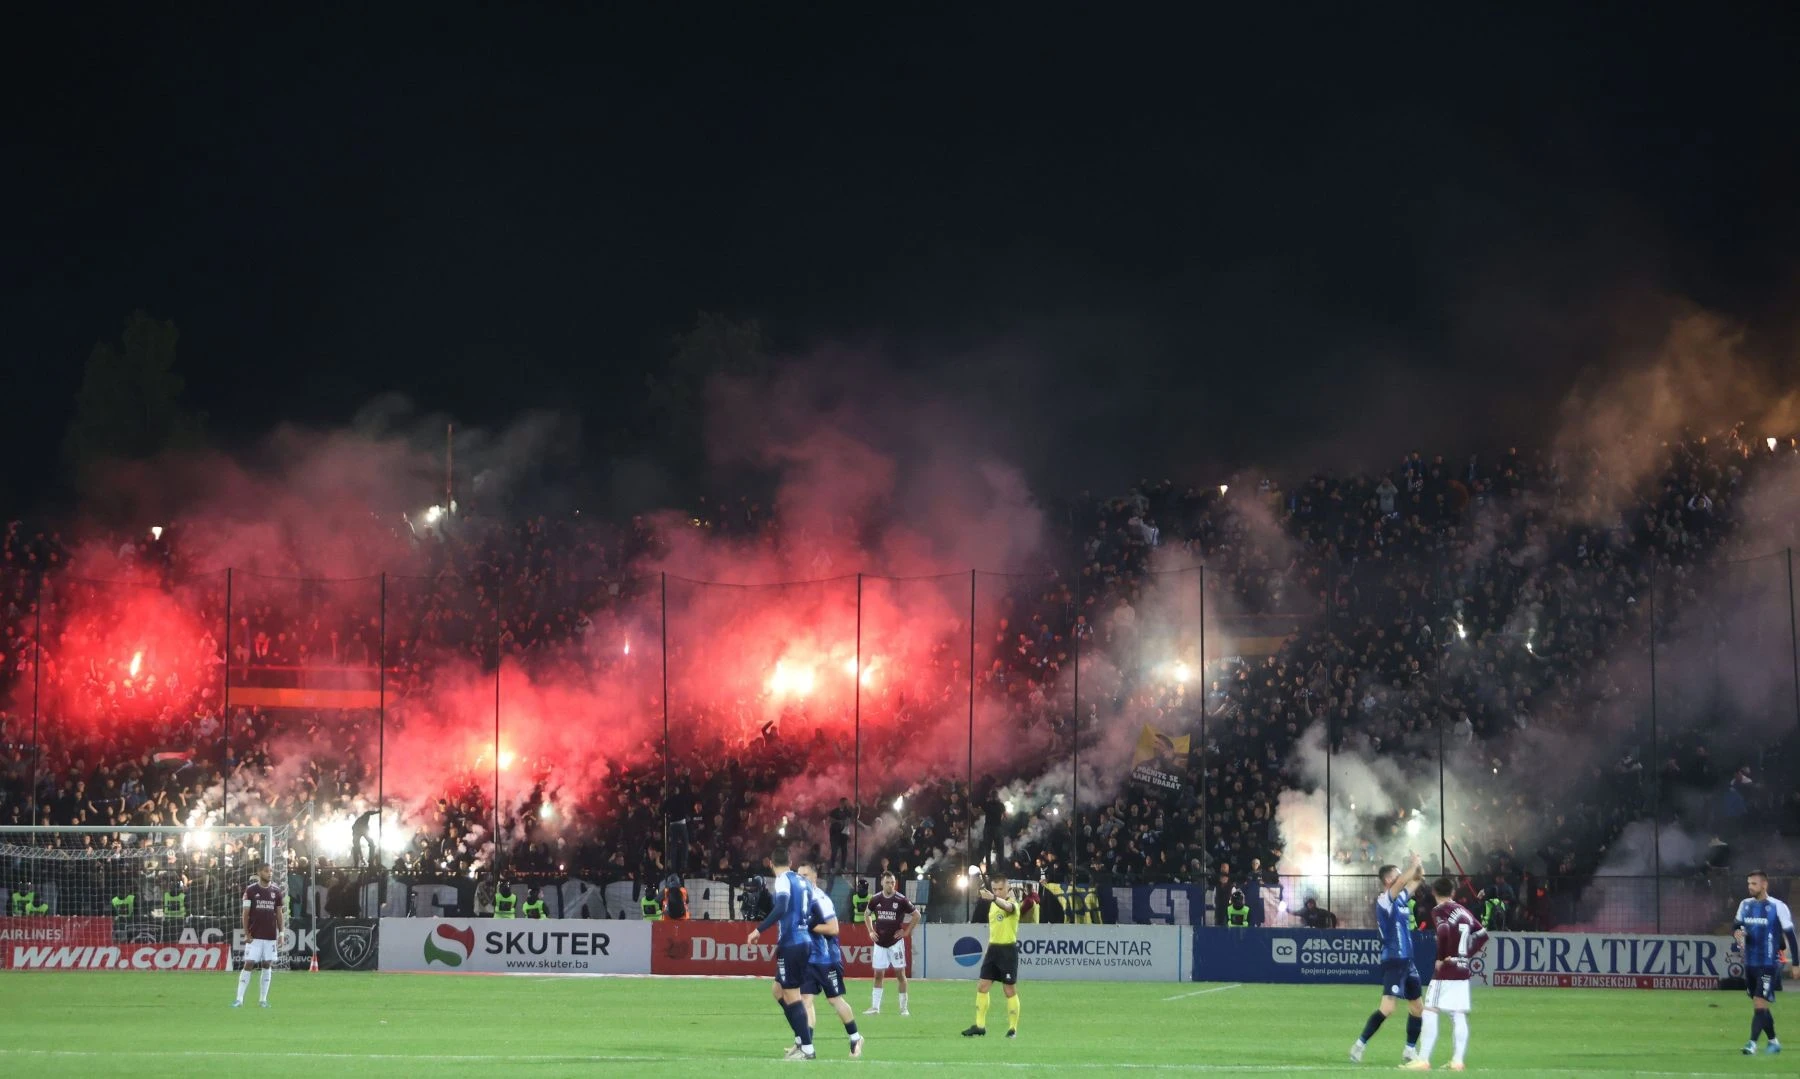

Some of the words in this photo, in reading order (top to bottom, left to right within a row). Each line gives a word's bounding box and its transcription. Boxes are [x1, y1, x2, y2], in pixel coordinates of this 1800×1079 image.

[1169, 775, 1179, 783] SE
[0, 928, 62, 940] AIRLINES
[1458, 923, 1470, 955] 7
[485, 931, 610, 956] SKUTER
[1016, 940, 1151, 956] ROFARMCENTAR
[1332, 939, 1384, 951] CENTR
[1035, 957, 1101, 967] ZDRAVSTVENA
[1104, 958, 1152, 967] USTANOVA
[1301, 952, 1381, 965] OSIGURAN
[1496, 937, 1719, 975] DERATIZER
[506, 959, 588, 969] www.skuter.ba
[1495, 974, 1558, 986] DEZINFEKCIJA
[1571, 976, 1637, 988] DEZINSEKCIJA
[1653, 978, 1718, 989] DERATIZACIJA
